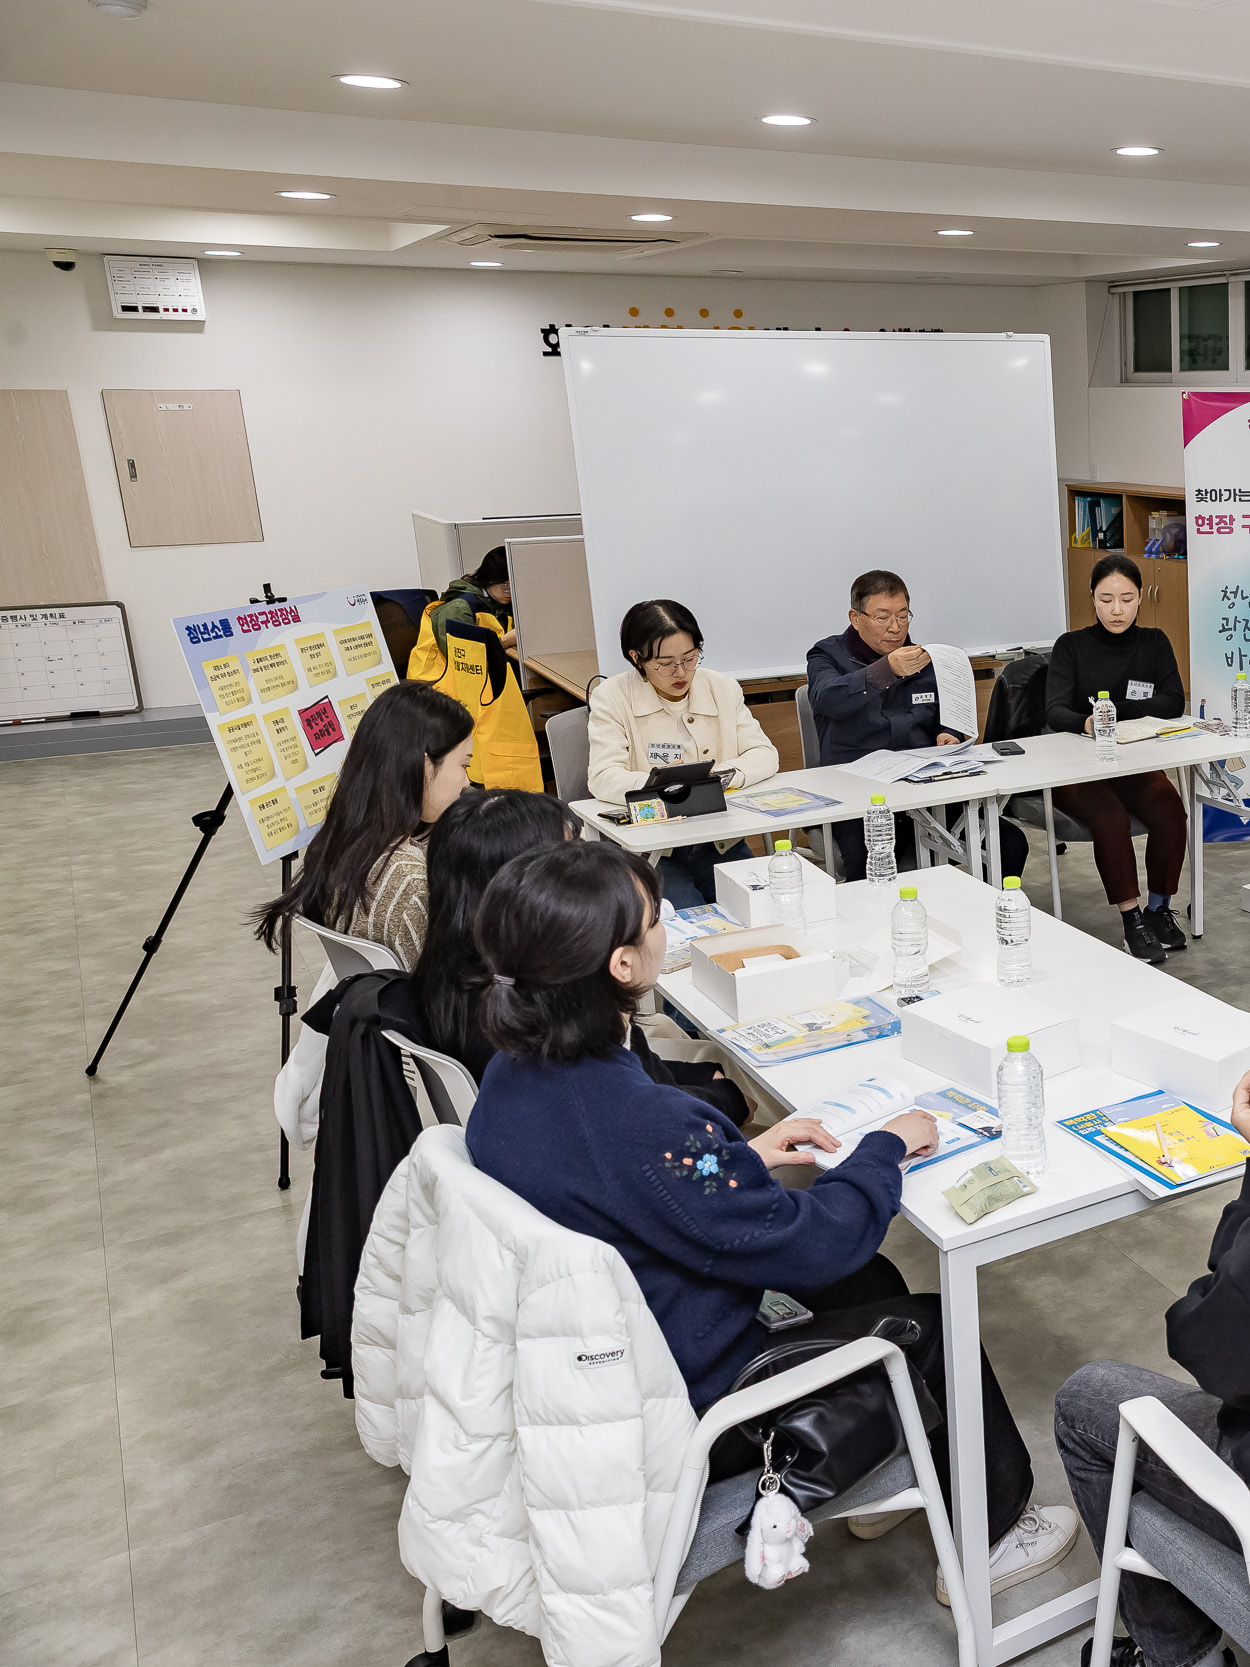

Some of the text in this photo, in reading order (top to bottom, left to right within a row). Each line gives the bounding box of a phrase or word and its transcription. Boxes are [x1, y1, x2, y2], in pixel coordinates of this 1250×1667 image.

[1194, 514, 1235, 534] 현장
[185, 605, 302, 644] 청년소통 현장구청장실
[305, 706, 329, 730] 광진청년
[577, 1349, 625, 1362] Discovery
